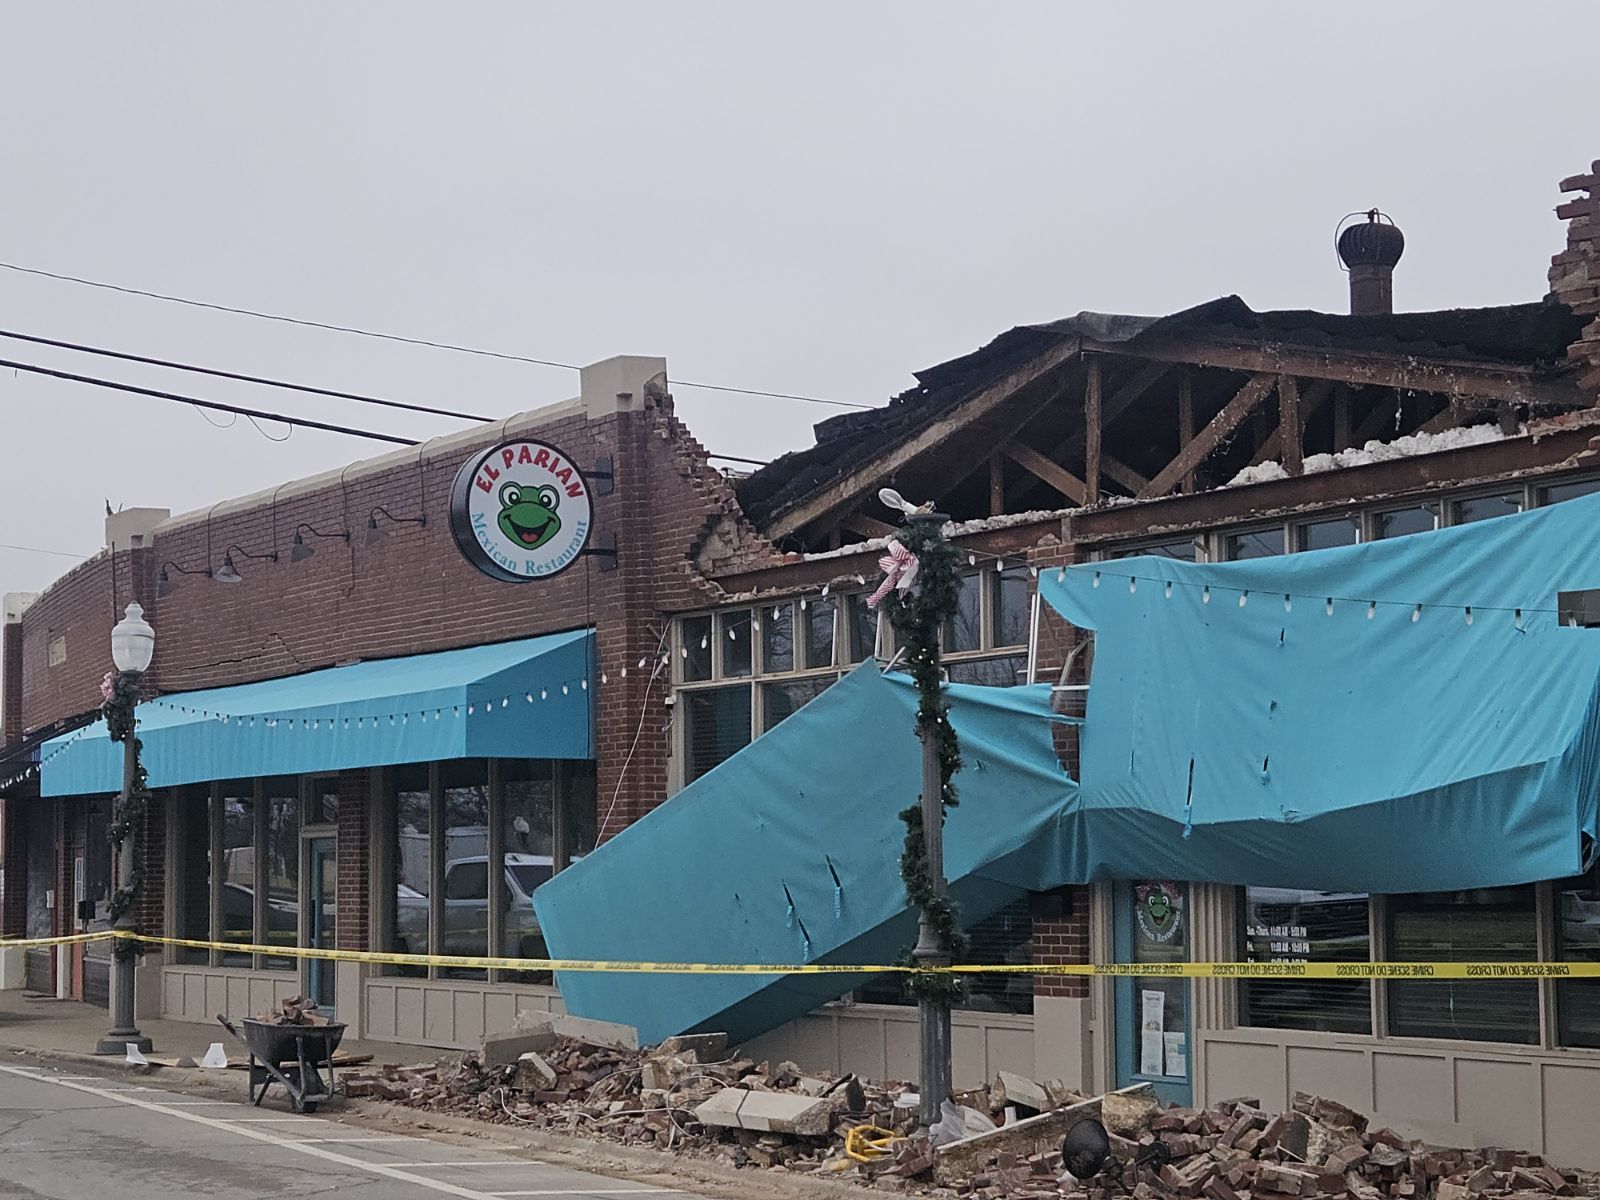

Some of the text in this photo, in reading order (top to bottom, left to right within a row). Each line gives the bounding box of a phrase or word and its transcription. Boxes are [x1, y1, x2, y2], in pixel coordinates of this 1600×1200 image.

[475, 445, 584, 498] EL PARIAN
[472, 512, 587, 574] Mexican Restaurant
